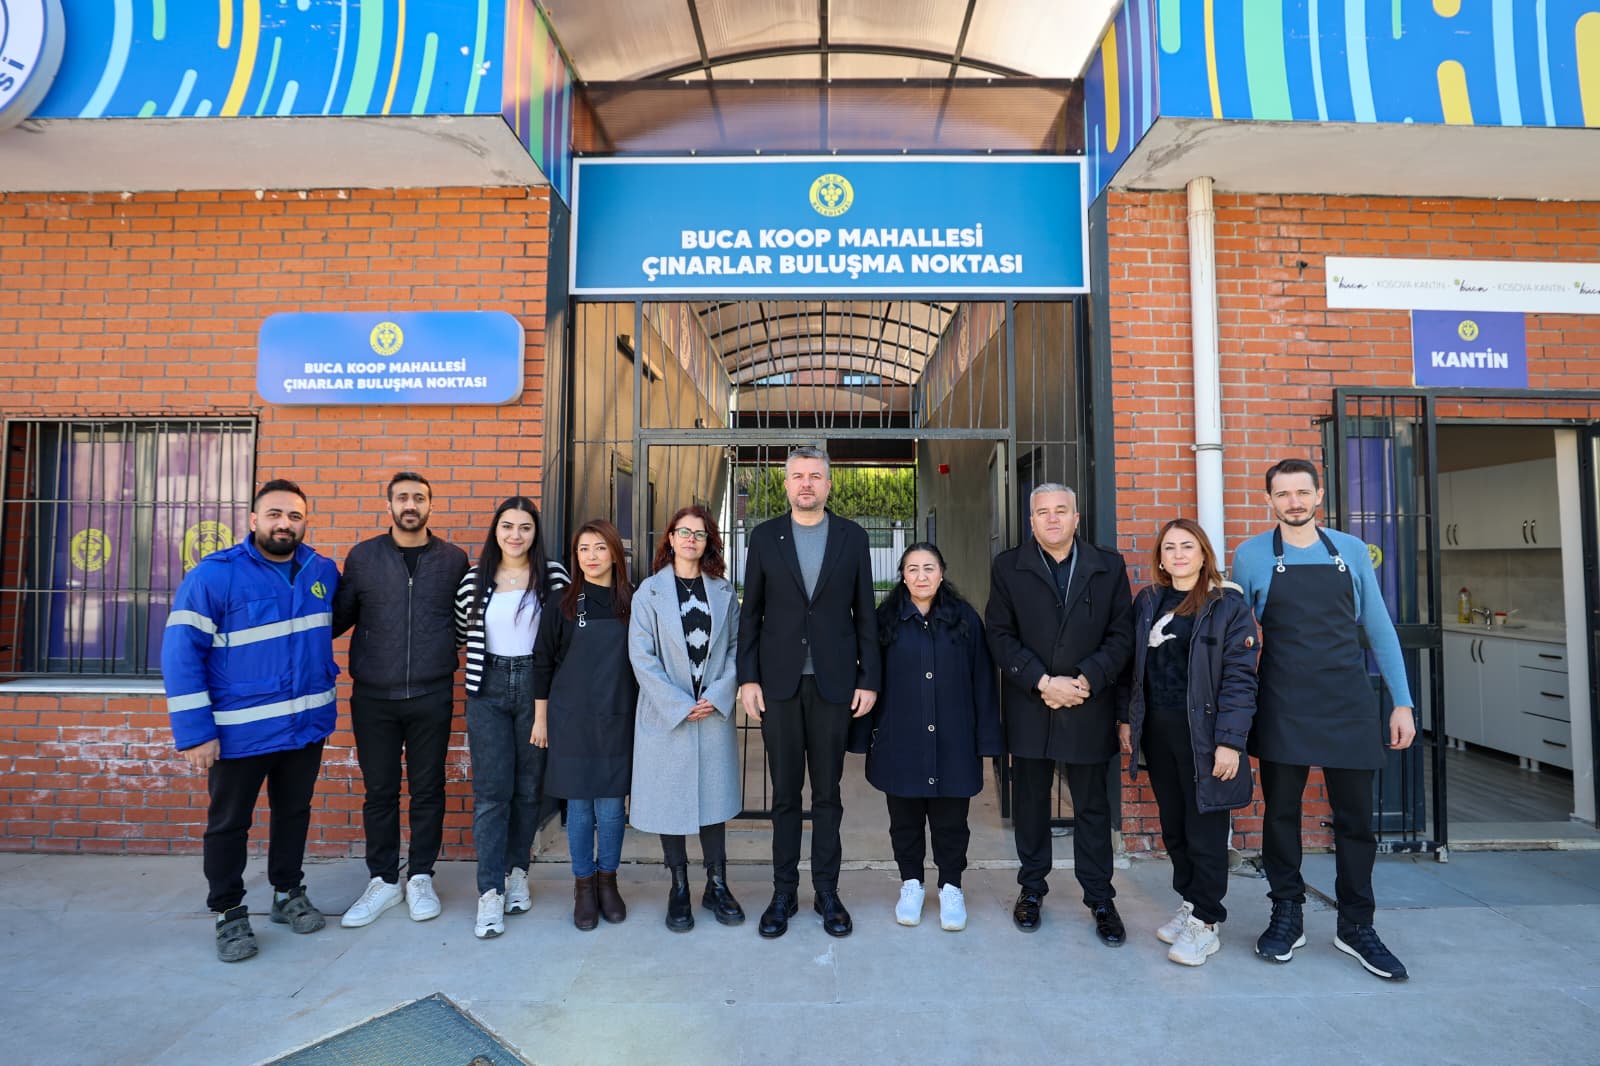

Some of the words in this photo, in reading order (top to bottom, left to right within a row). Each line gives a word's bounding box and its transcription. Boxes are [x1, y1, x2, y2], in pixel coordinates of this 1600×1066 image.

[681, 229, 753, 249] BUCA
[759, 228, 832, 248] KOOP
[838, 222, 983, 248] MAHALLESİ
[642, 255, 773, 281] ÇINARLAR
[779, 254, 905, 279] BULUŞMA
[911, 254, 1023, 274] NOKTASI
[304, 362, 344, 374] BUCA
[347, 362, 386, 373] KOOP
[389, 358, 466, 373] MAHALLESİ
[1431, 347, 1509, 369] KANTİN
[284, 378, 354, 392] ÇINARLAR
[357, 377, 424, 392] BULUŞMA
[427, 376, 487, 389] NOKTASI
